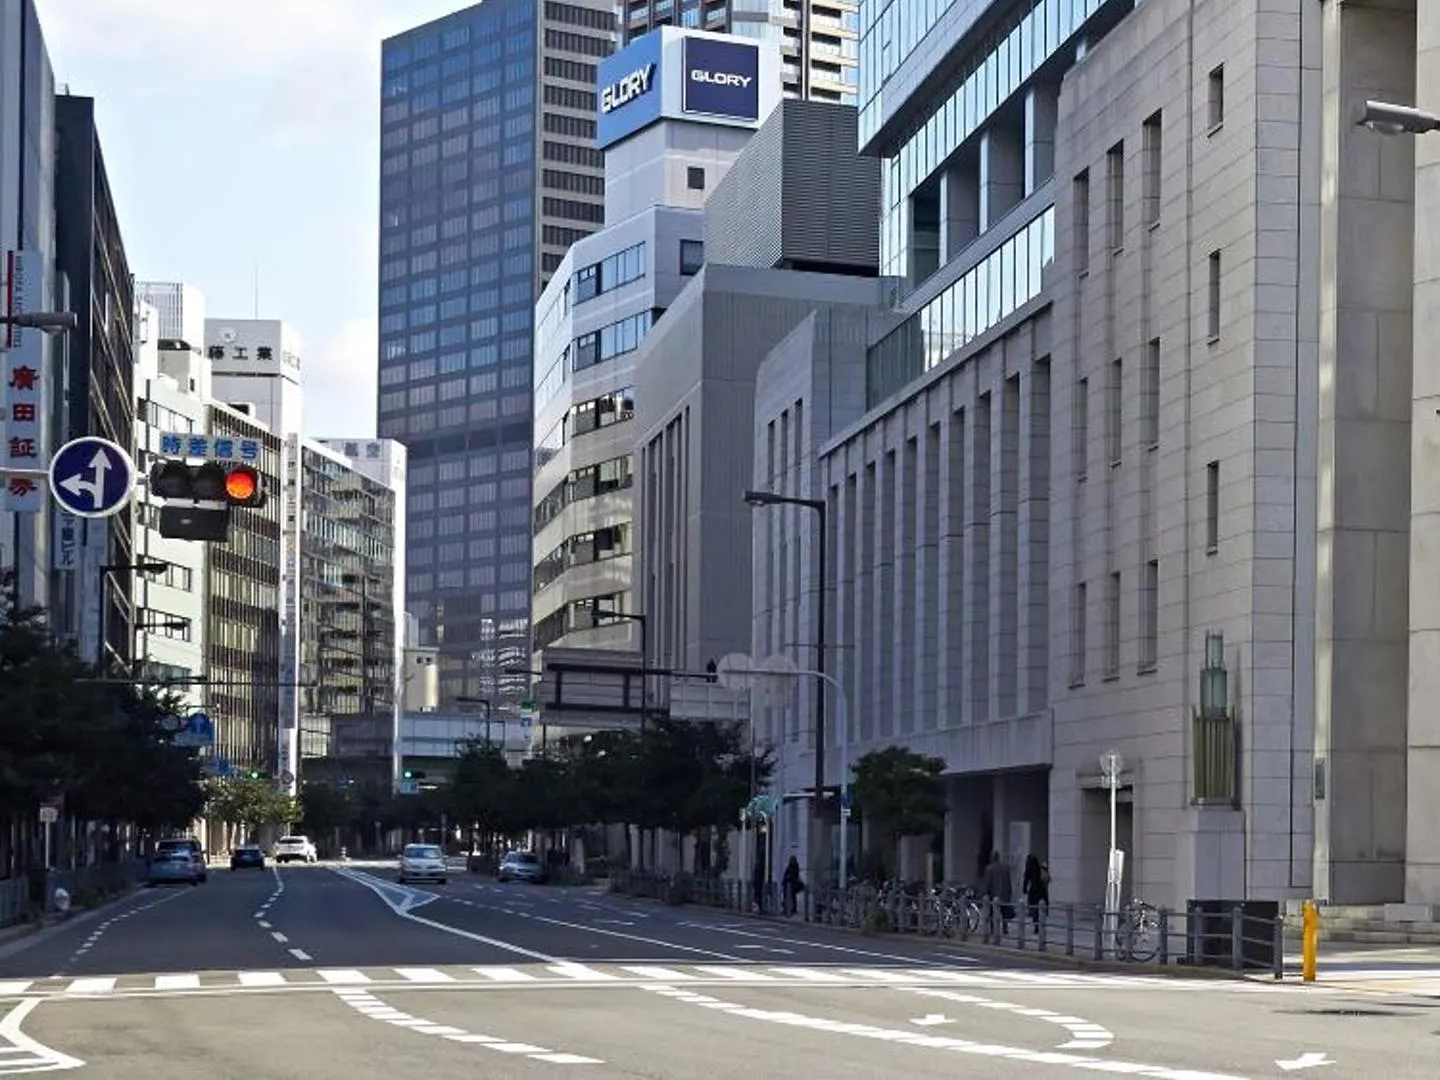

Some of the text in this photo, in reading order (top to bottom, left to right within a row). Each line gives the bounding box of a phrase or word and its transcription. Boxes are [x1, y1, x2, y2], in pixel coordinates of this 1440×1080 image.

[601, 63, 656, 114] GLORY
[691, 69, 752, 88] GLORY
[162, 435, 258, 459] 時差信号
